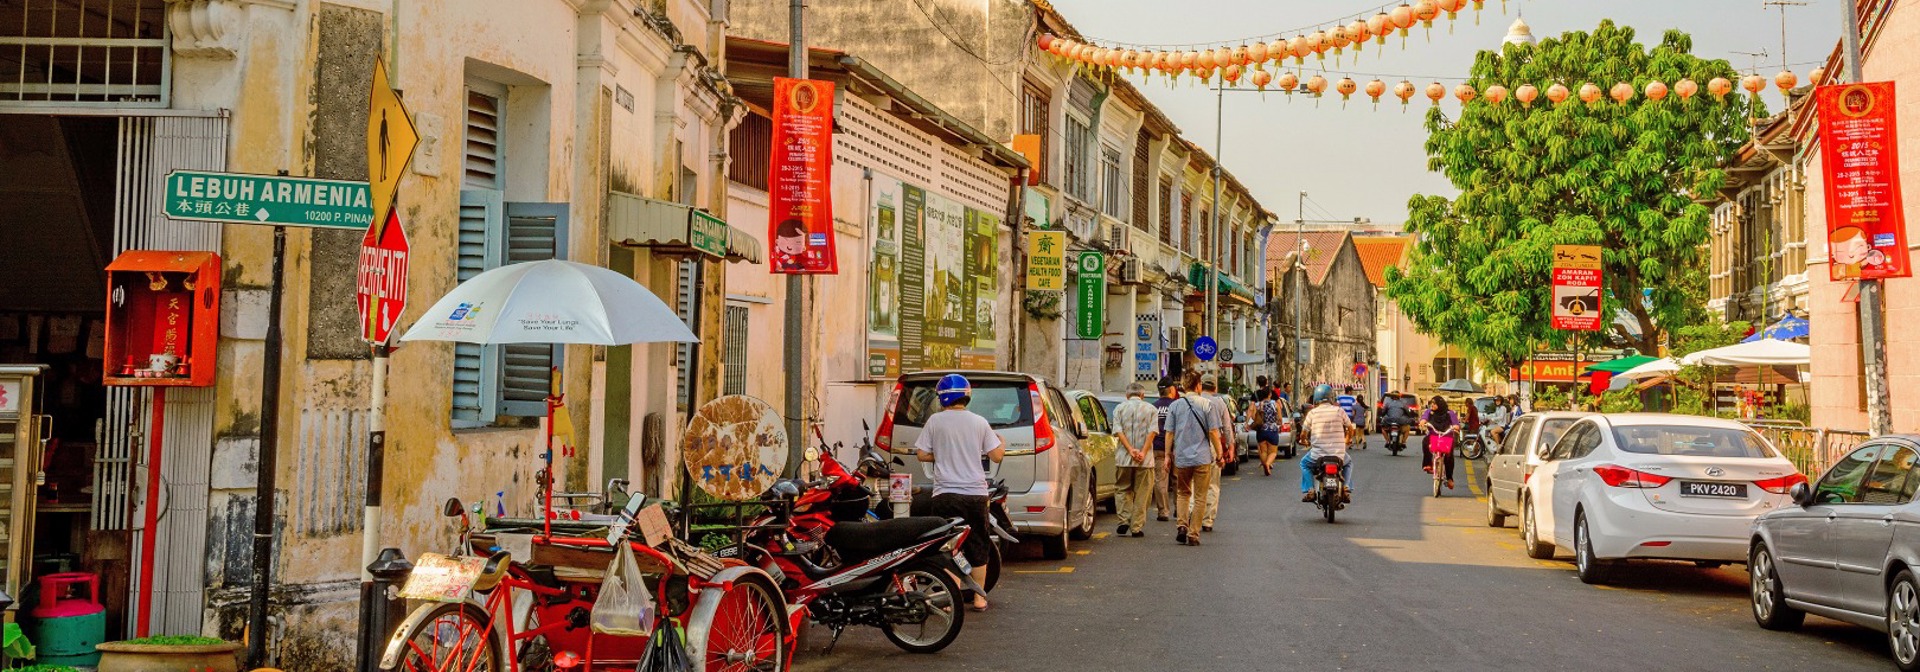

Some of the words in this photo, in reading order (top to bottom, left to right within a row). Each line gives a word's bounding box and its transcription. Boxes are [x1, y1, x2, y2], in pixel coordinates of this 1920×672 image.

[176, 176, 255, 201] LEBUH
[260, 182, 373, 208] ARMENIA
[176, 199, 250, 216] 本頭公巷
[304, 210, 332, 222] 10200
[334, 212, 342, 222] P.
[1031, 256, 1060, 266] VEGETARIAN
[359, 246, 406, 301] BERHENTI
[1029, 267, 1047, 276] HEALTH
[1048, 268, 1061, 277] FOOD
[1038, 278, 1051, 287] CAFE
